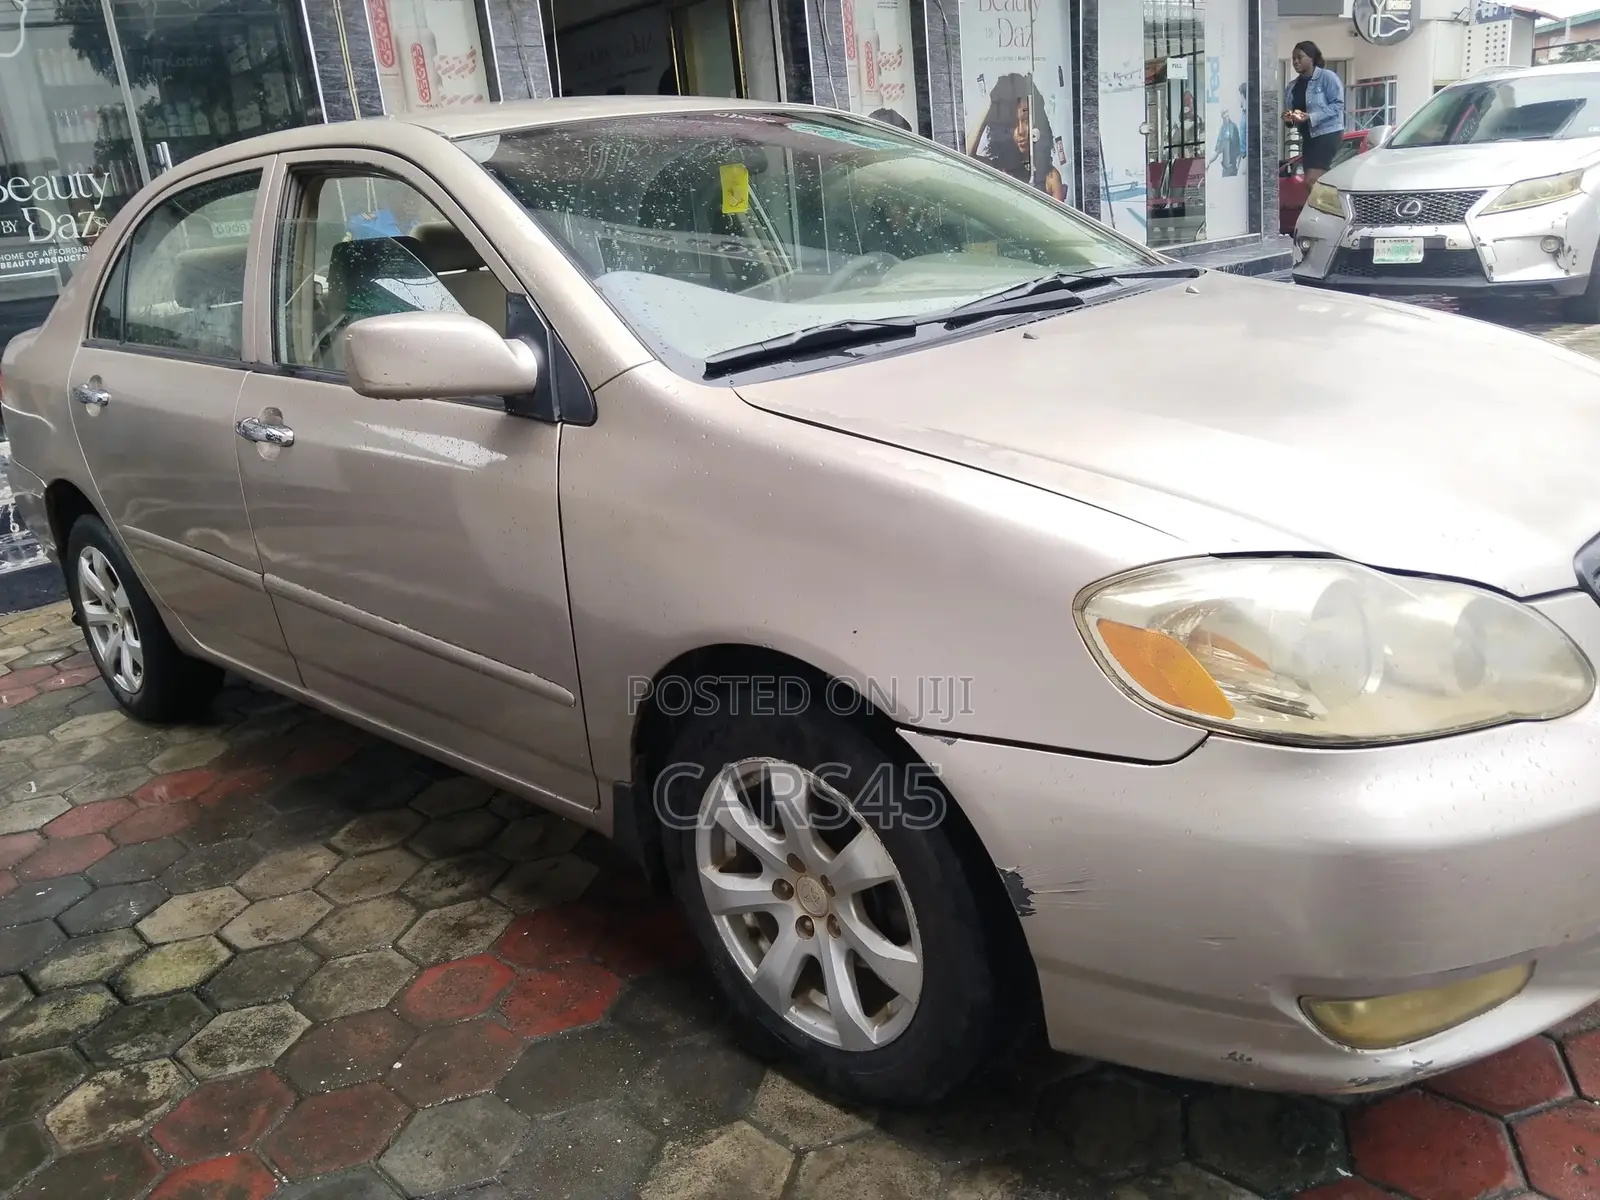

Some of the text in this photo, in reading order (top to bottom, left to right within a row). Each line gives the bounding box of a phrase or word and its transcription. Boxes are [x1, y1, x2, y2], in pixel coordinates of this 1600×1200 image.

[1, 206, 100, 242] BY Daz
[27, 251, 39, 259] OF
[42, 245, 92, 257] AFFORDAB
[0, 253, 88, 269] BEAUTY PRODUCTS
